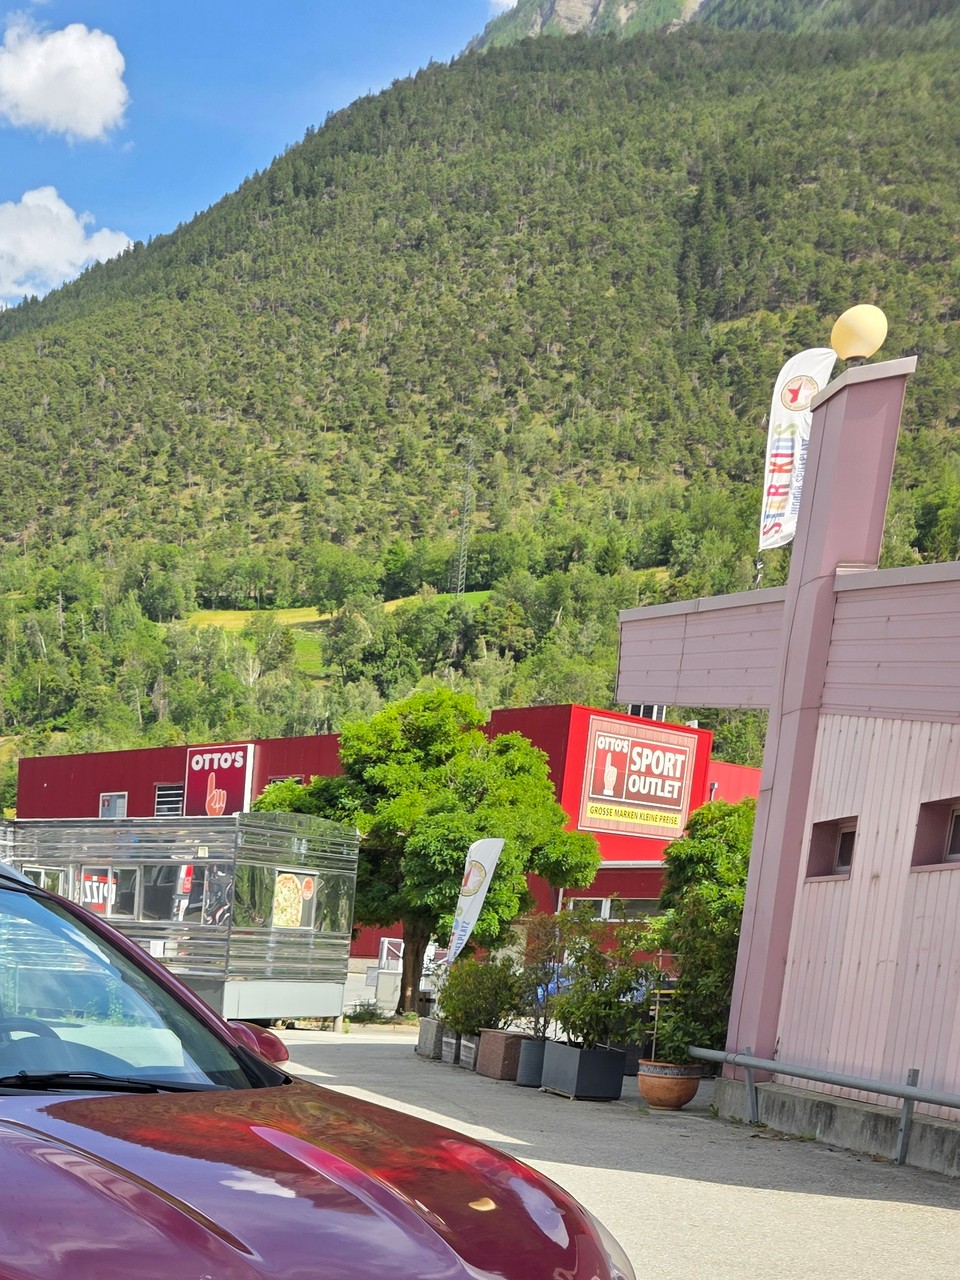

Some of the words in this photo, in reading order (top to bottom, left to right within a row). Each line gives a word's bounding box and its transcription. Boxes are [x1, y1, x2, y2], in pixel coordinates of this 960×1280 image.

[769, 423, 799, 474] KIDS
[762, 483, 790, 537] STAR
[597, 736, 629, 754] OTTO'S
[191, 751, 244, 771] OTTO'S
[630, 746, 686, 778] SPORT
[628, 774, 682, 799] OUTLET
[589, 805, 613, 817] GROSSE
[614, 808, 639, 819] MARKEN
[640, 812, 659, 822] KLEINE
